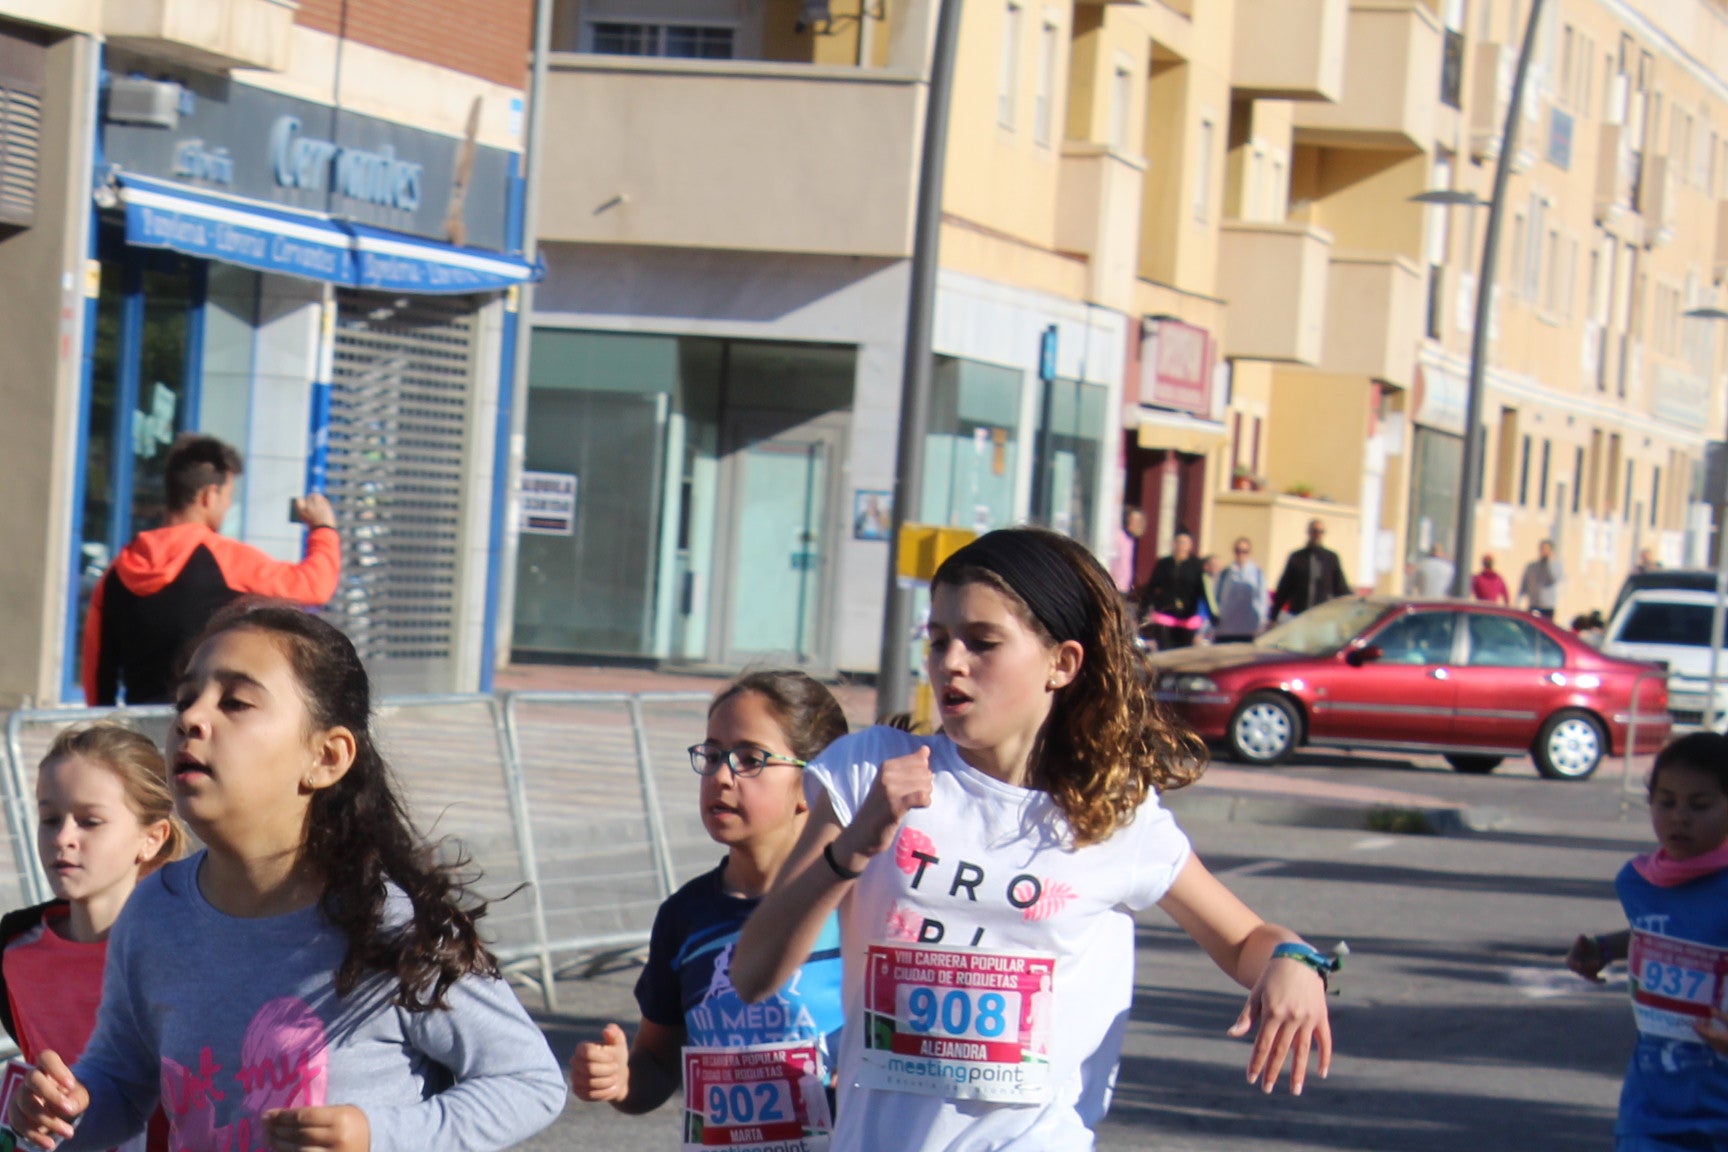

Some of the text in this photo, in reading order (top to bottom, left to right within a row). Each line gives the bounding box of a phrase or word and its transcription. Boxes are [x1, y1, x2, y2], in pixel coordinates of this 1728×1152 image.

[894, 950, 1025, 973] VIII CARRERA POPULAR
[893, 967, 1018, 989] CIUDAD DE ROQUETAS
[1643, 960, 1707, 1000] 937
[721, 1004, 817, 1031] MEDIA
[908, 987, 1006, 1038] 908
[741, 1050, 787, 1066] POPULAR
[920, 1039, 988, 1061] ALEJANDRA
[709, 1082, 784, 1125] 902
[730, 1128, 764, 1143] MARTA
